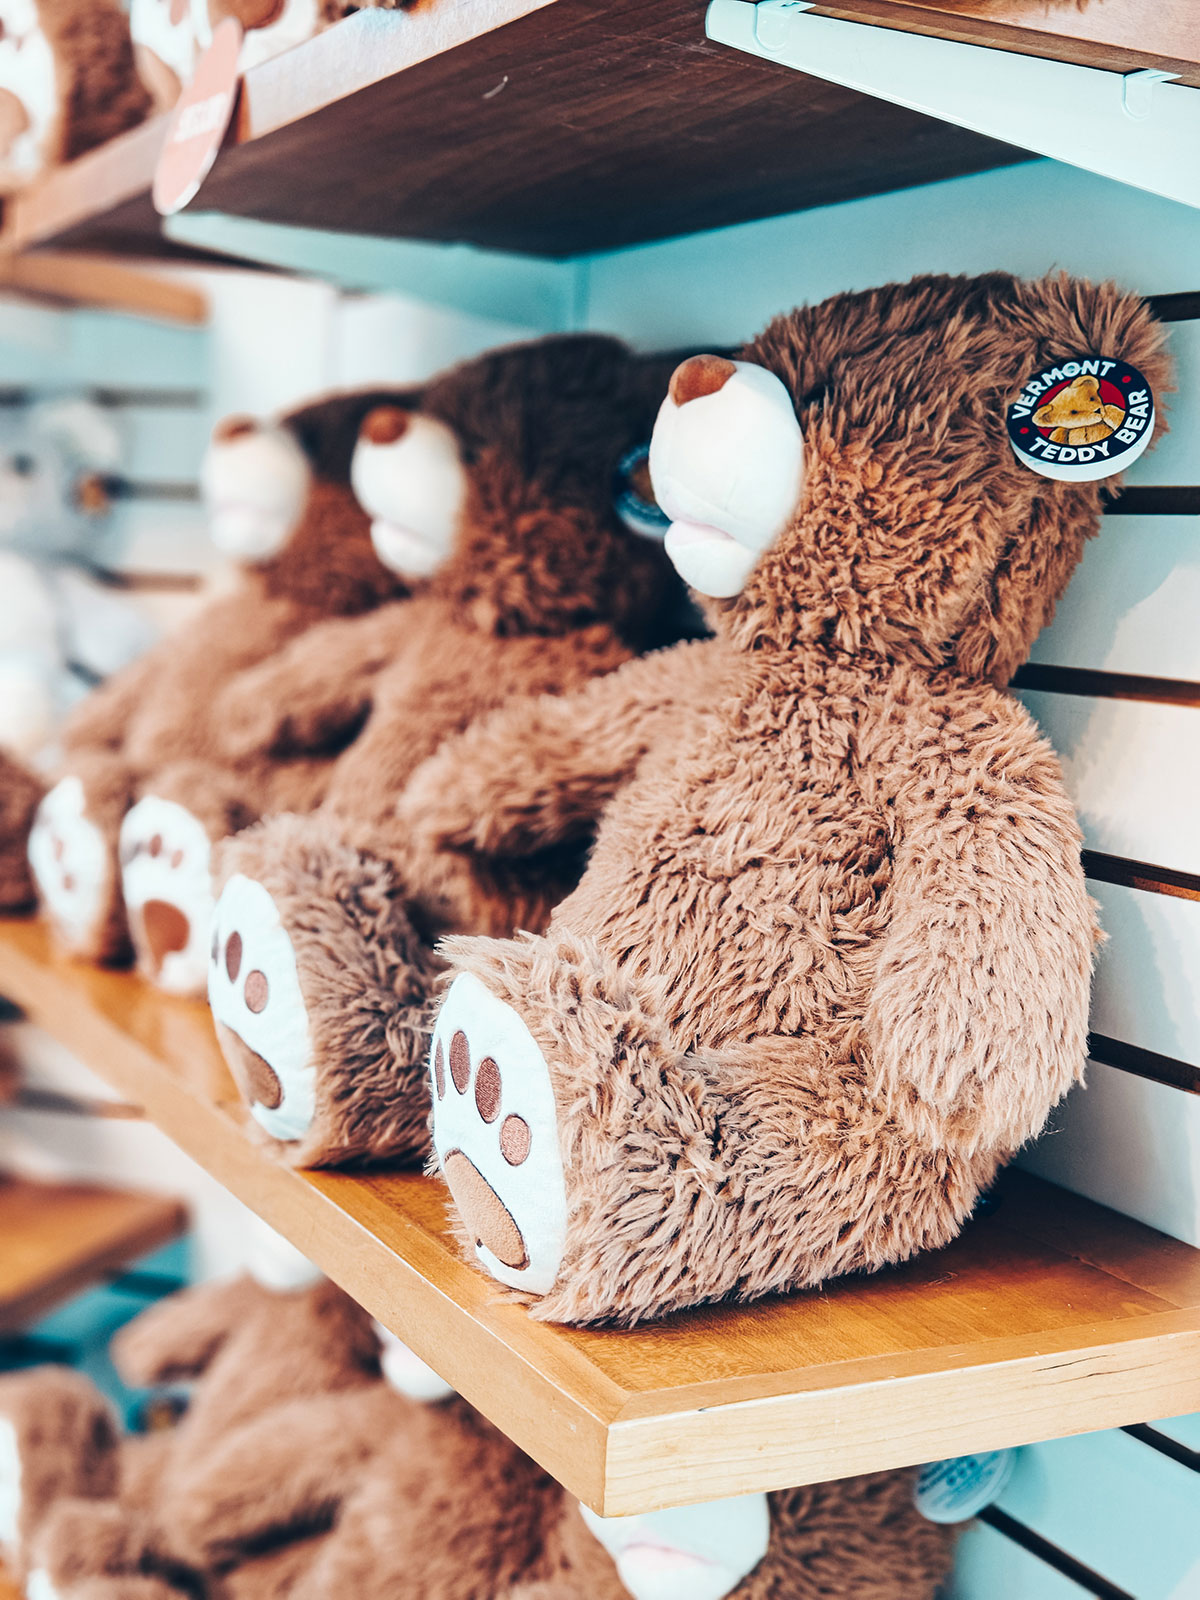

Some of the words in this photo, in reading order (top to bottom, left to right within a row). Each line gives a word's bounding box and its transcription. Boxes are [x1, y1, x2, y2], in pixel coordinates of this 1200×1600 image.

[1012, 360, 1116, 419] VERMONT
[1029, 437, 1111, 462] TEDDY
[1114, 389, 1148, 444] BEAR
